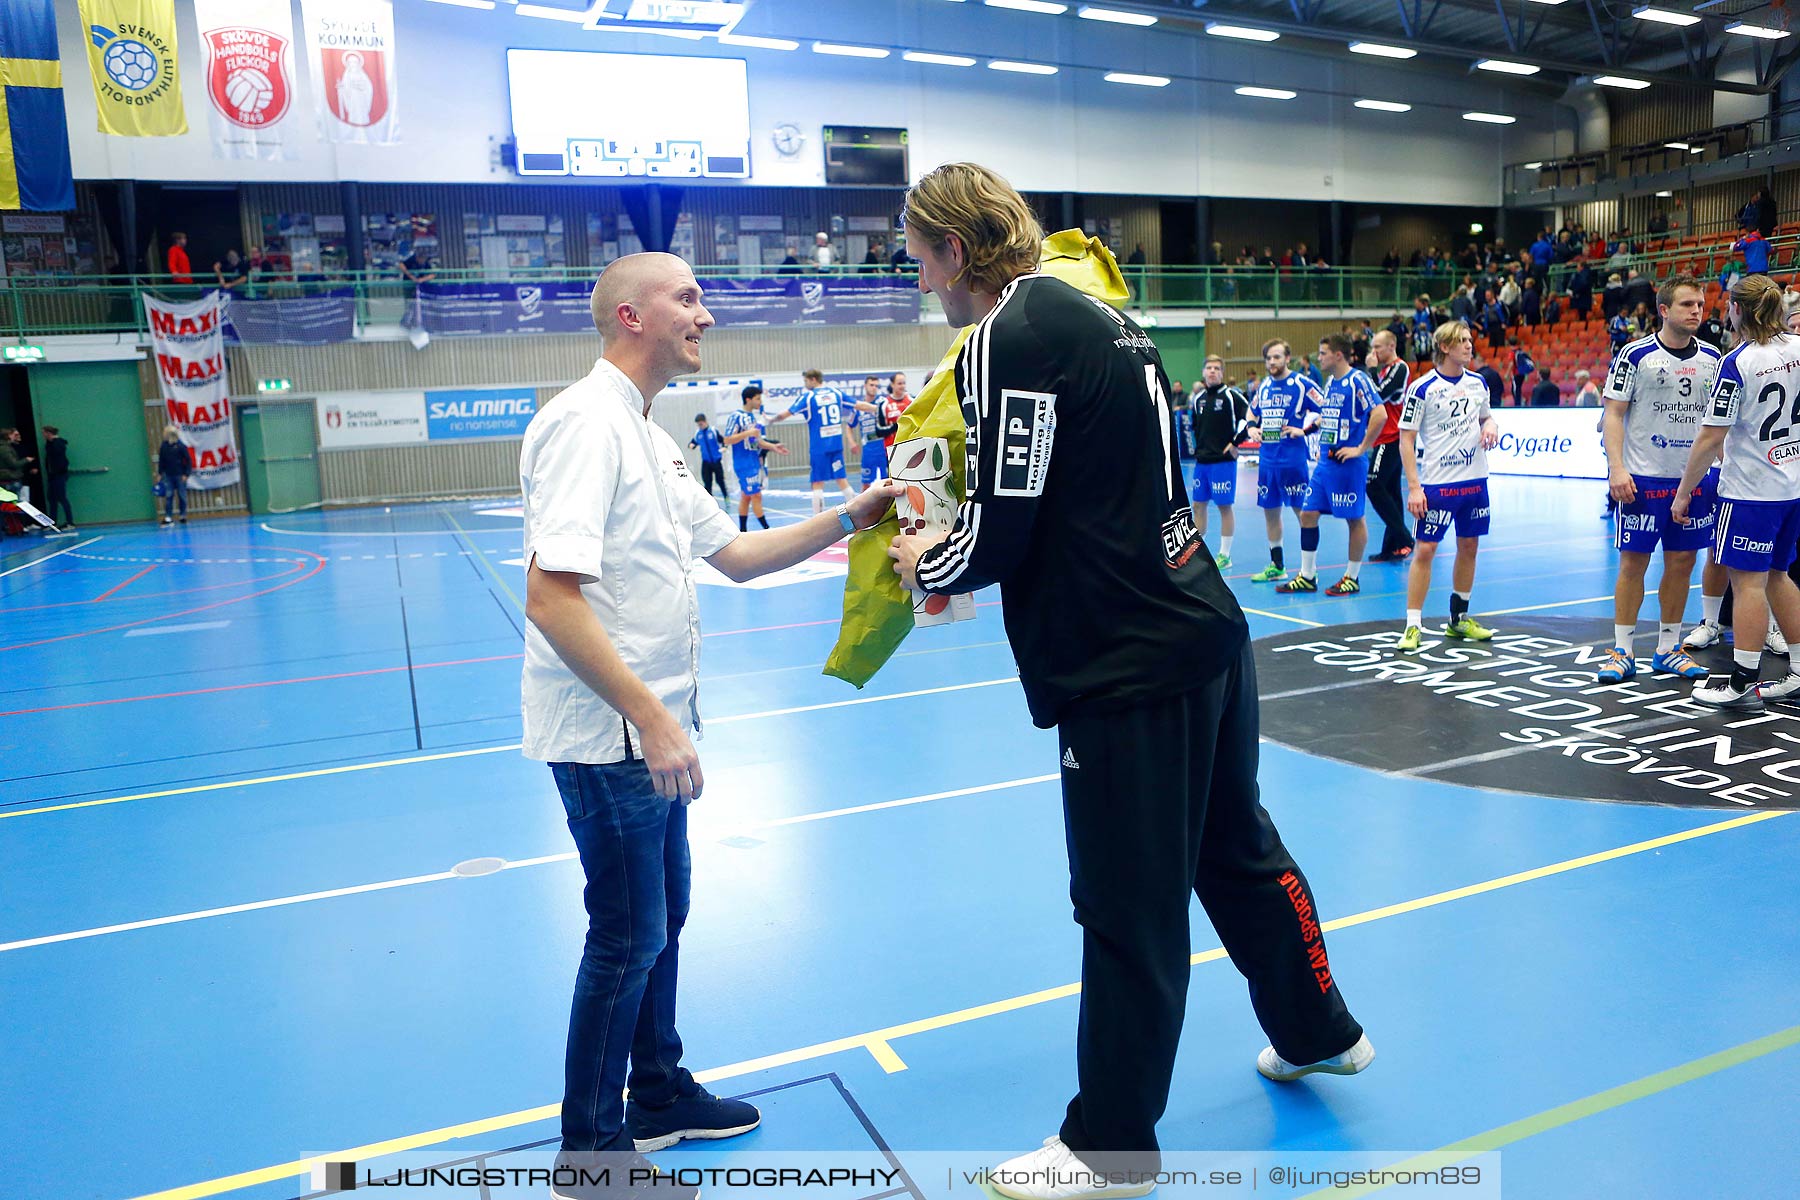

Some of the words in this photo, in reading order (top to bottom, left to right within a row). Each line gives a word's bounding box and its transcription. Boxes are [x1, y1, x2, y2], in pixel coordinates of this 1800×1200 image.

[118, 24, 169, 55] SVENSK
[220, 31, 271, 48] SKÖVDE
[318, 33, 385, 47] KOMMUN
[215, 43, 279, 63] HANDBOLLS
[226, 56, 271, 73] FLICKOR
[101, 58, 174, 106] ELITHANDBOLL
[824, 128, 833, 142] H
[151, 307, 217, 335] MAXI
[157, 352, 222, 379] MAXI
[1679, 377, 1692, 397] 3
[167, 398, 229, 424] MAXI
[817, 404, 841, 426] 19
[1449, 398, 1469, 418] 27
[450, 422, 463, 432] no
[1668, 413, 1697, 425] Skåne
[1005, 417, 1030, 466] HP
[1144, 364, 1172, 501] 1
[1029, 429, 1045, 490] Holding
[1038, 400, 1047, 423] AB
[1500, 433, 1572, 457] Cygate
[1439, 487, 1459, 497] TEAM
[1644, 489, 1669, 499] TEAM
[1424, 524, 1438, 536] 27
[1622, 532, 1631, 544] 3
[1344, 631, 1800, 743] FASTIGHET
[1499, 727, 1793, 806] SKÖVDE
[1306, 940, 1333, 994] TEAM
